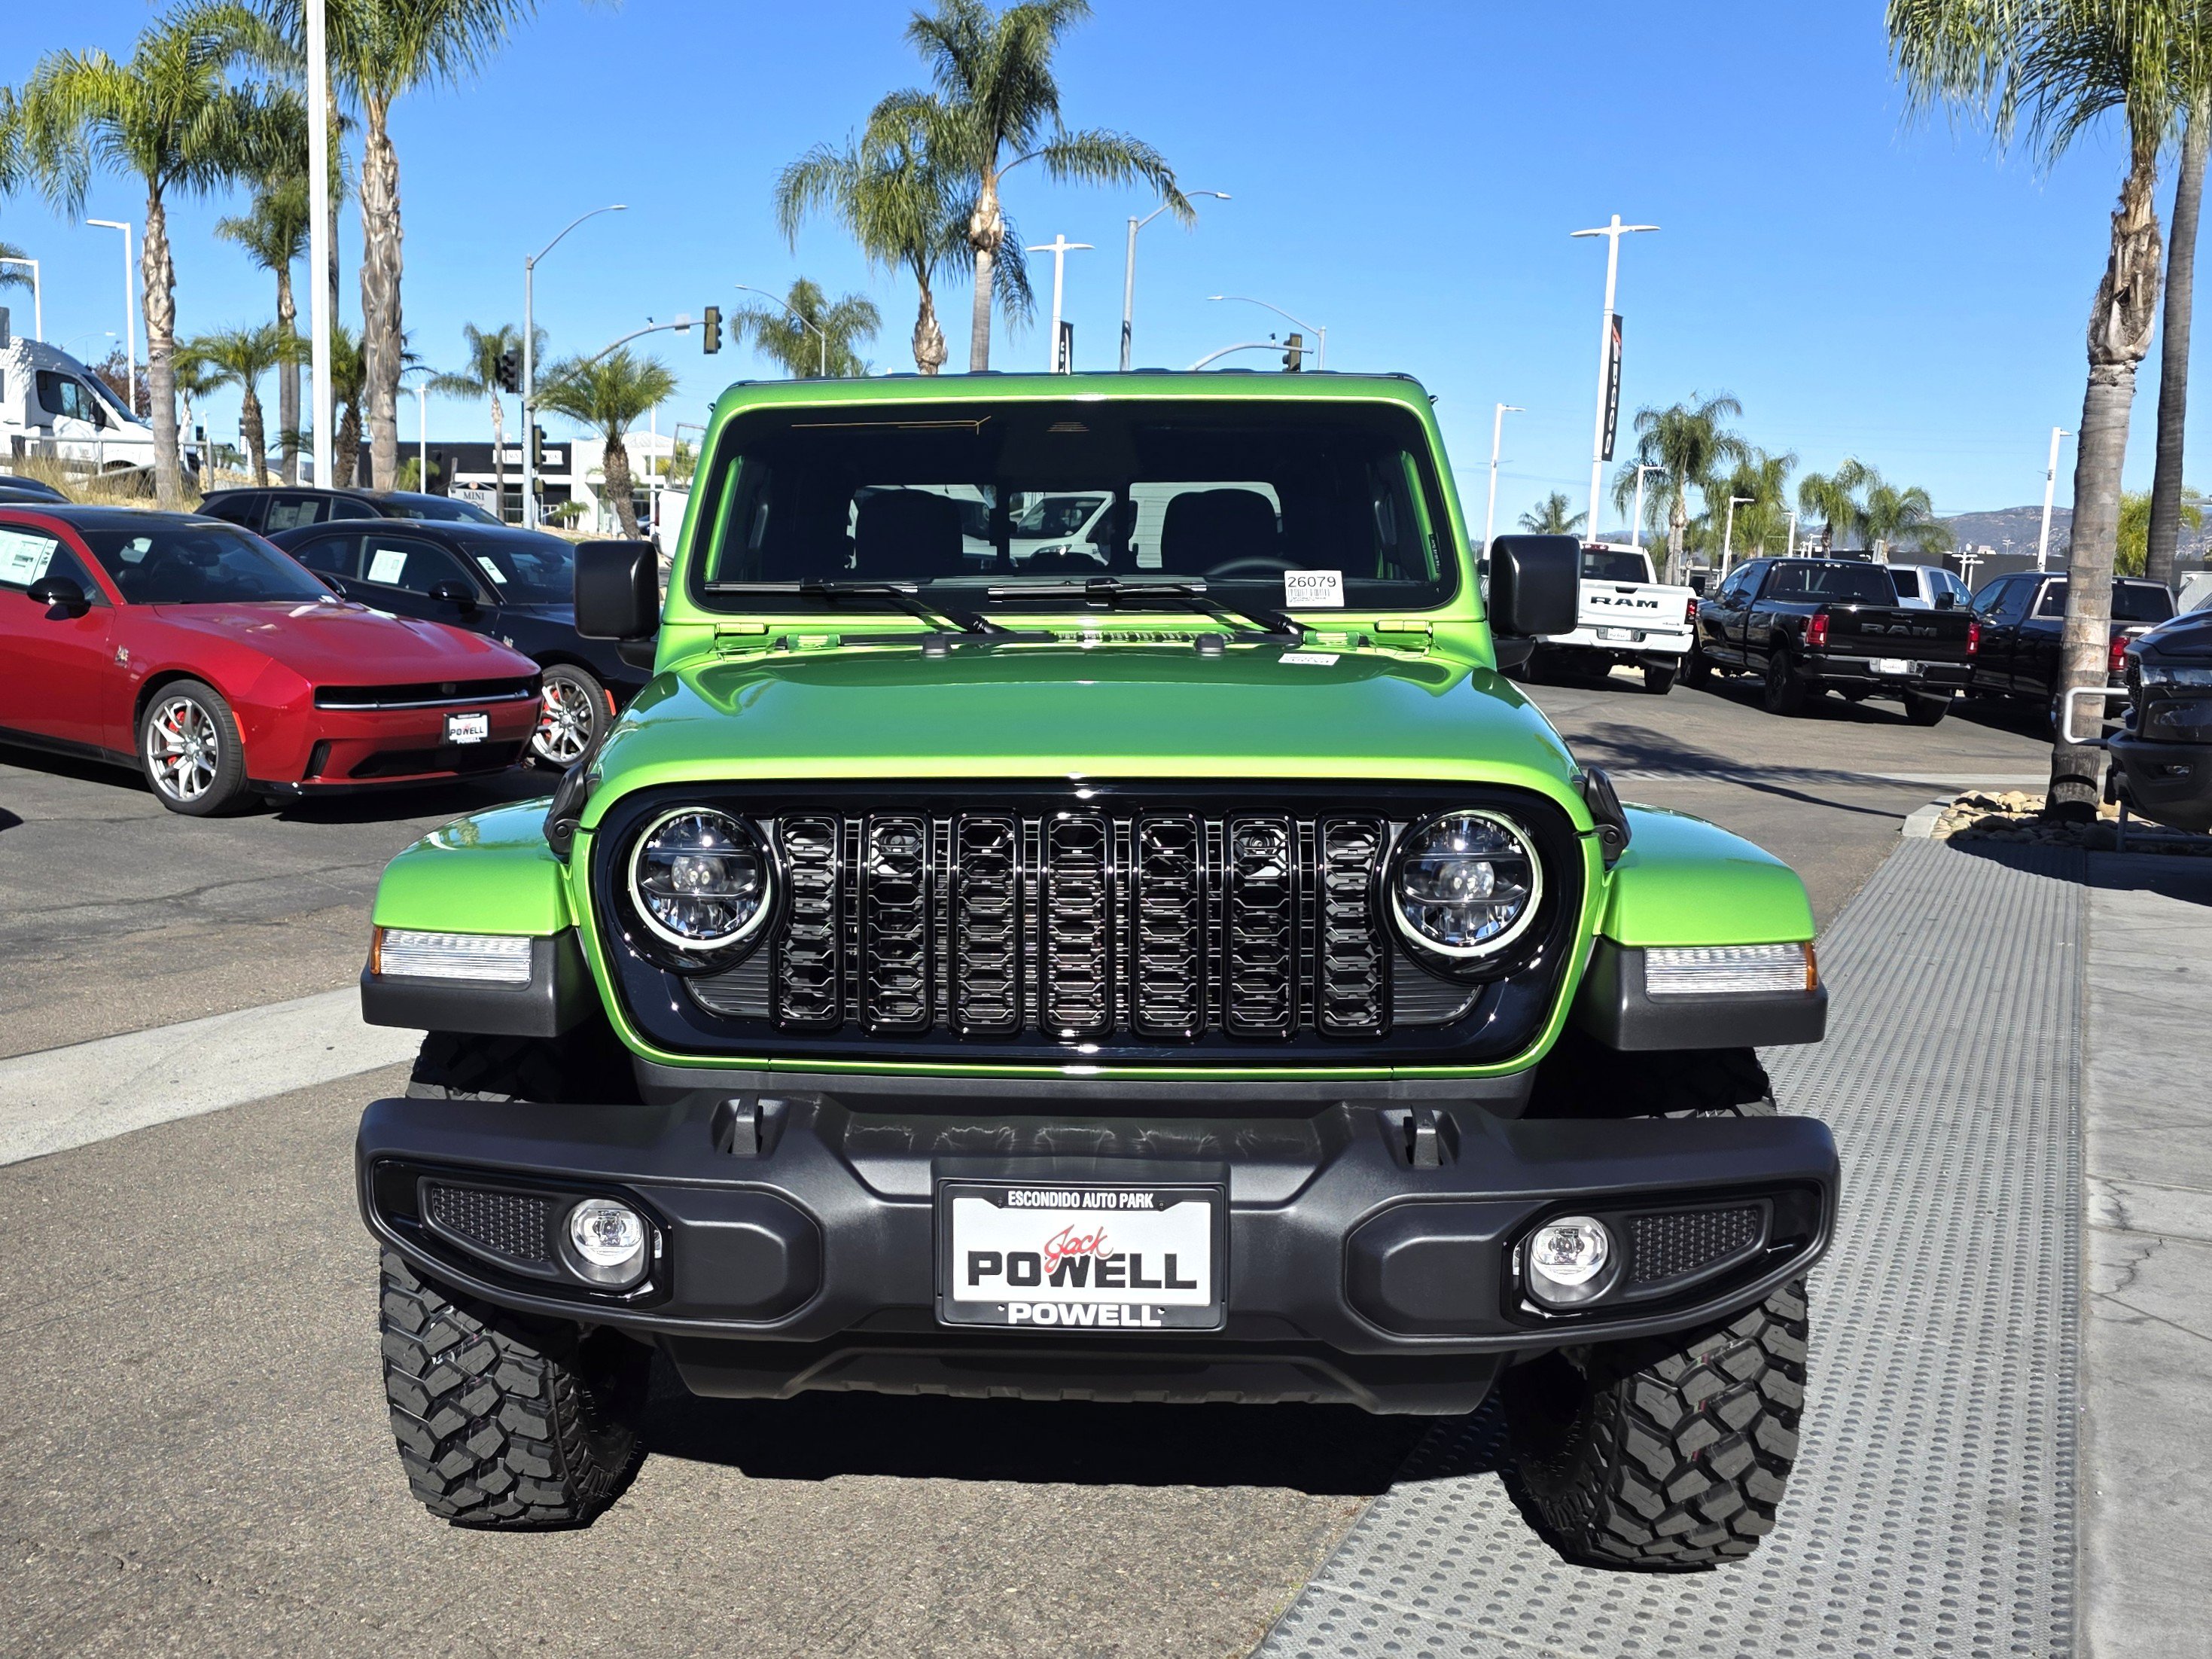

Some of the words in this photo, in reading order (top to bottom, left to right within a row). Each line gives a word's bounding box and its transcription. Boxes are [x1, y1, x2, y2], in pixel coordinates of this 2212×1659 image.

[463, 491, 485, 501] MINI
[1287, 576, 1336, 587] 26079
[1590, 596, 1659, 608] RAM
[1860, 623, 1938, 637] RAM
[449, 726, 484, 736] POWELL
[1007, 1190, 1081, 1208] ESCONDIDO
[1083, 1191, 1117, 1208] AUTO
[1120, 1193, 1154, 1209] PARK
[1044, 1224, 1114, 1273] Jack
[967, 1250, 1197, 1289] POWELL
[1007, 1302, 1162, 1327] POWELL
